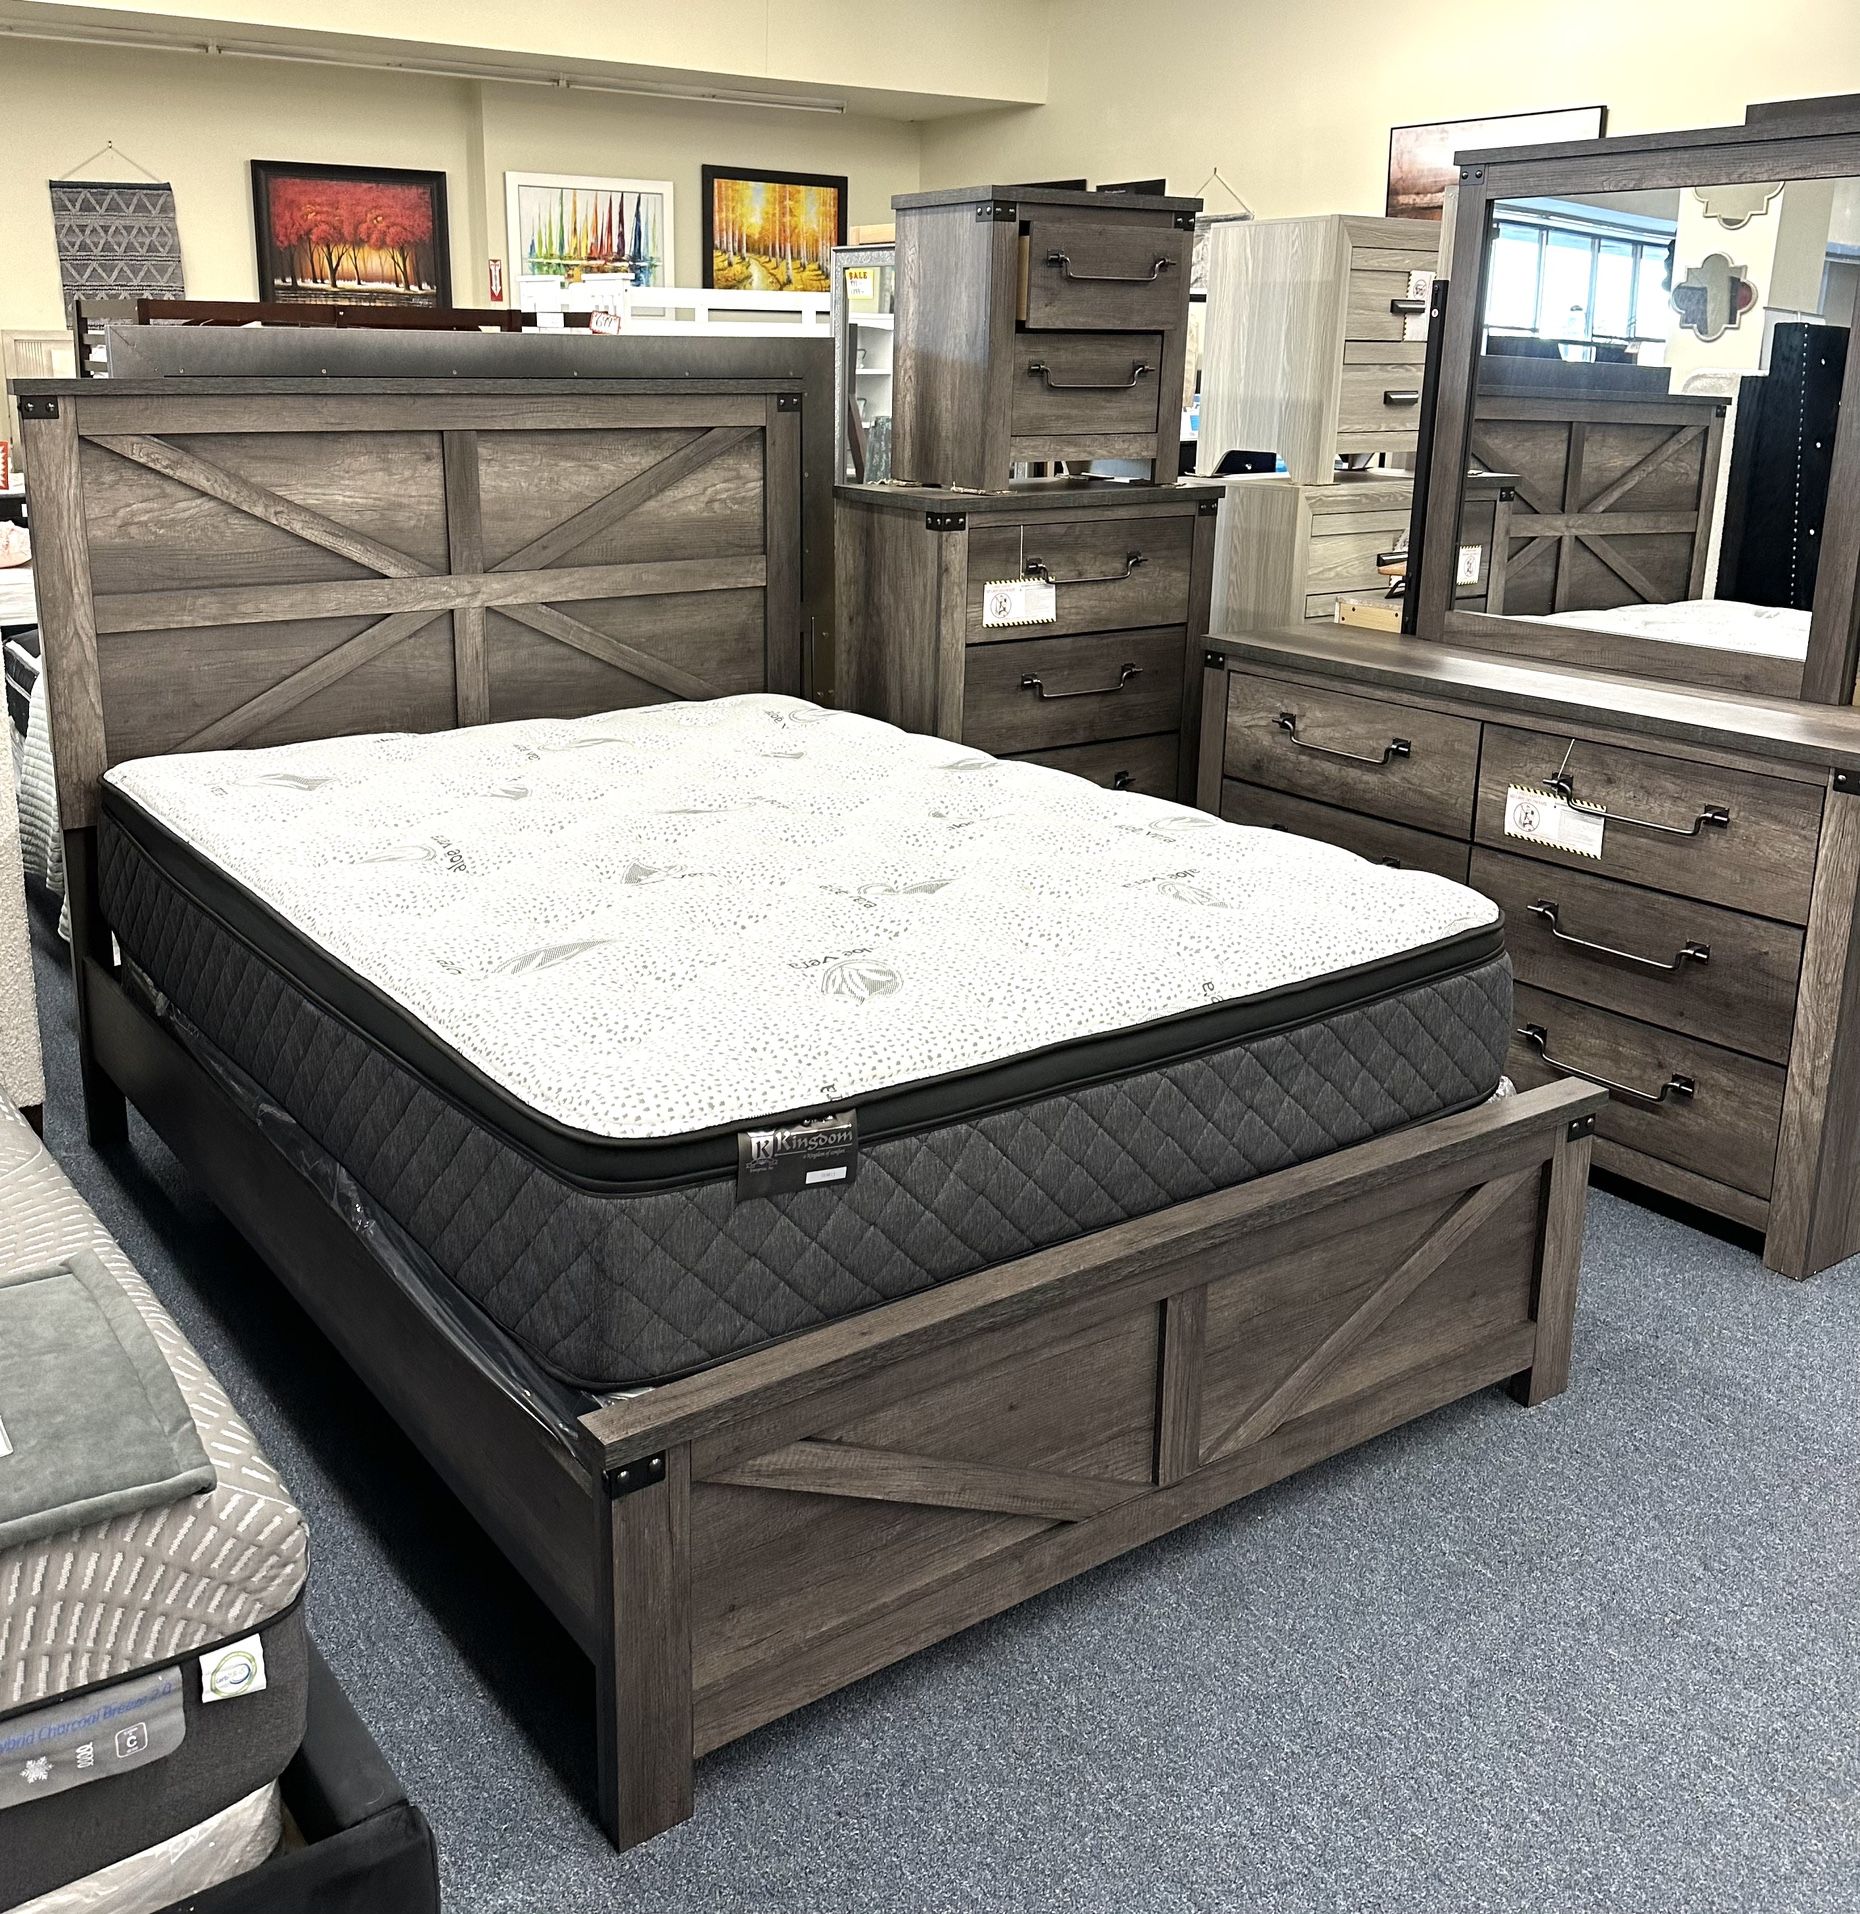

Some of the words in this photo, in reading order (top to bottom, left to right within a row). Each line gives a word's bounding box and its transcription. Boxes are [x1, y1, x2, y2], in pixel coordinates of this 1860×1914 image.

[848, 271, 868, 280] SALE
[447, 848, 467, 873] aloe
[786, 955, 840, 970] vera
[775, 1130, 853, 1152] Kingdom
[38, 1708, 100, 1740] Charcoal
[126, 1735, 138, 1748] C
